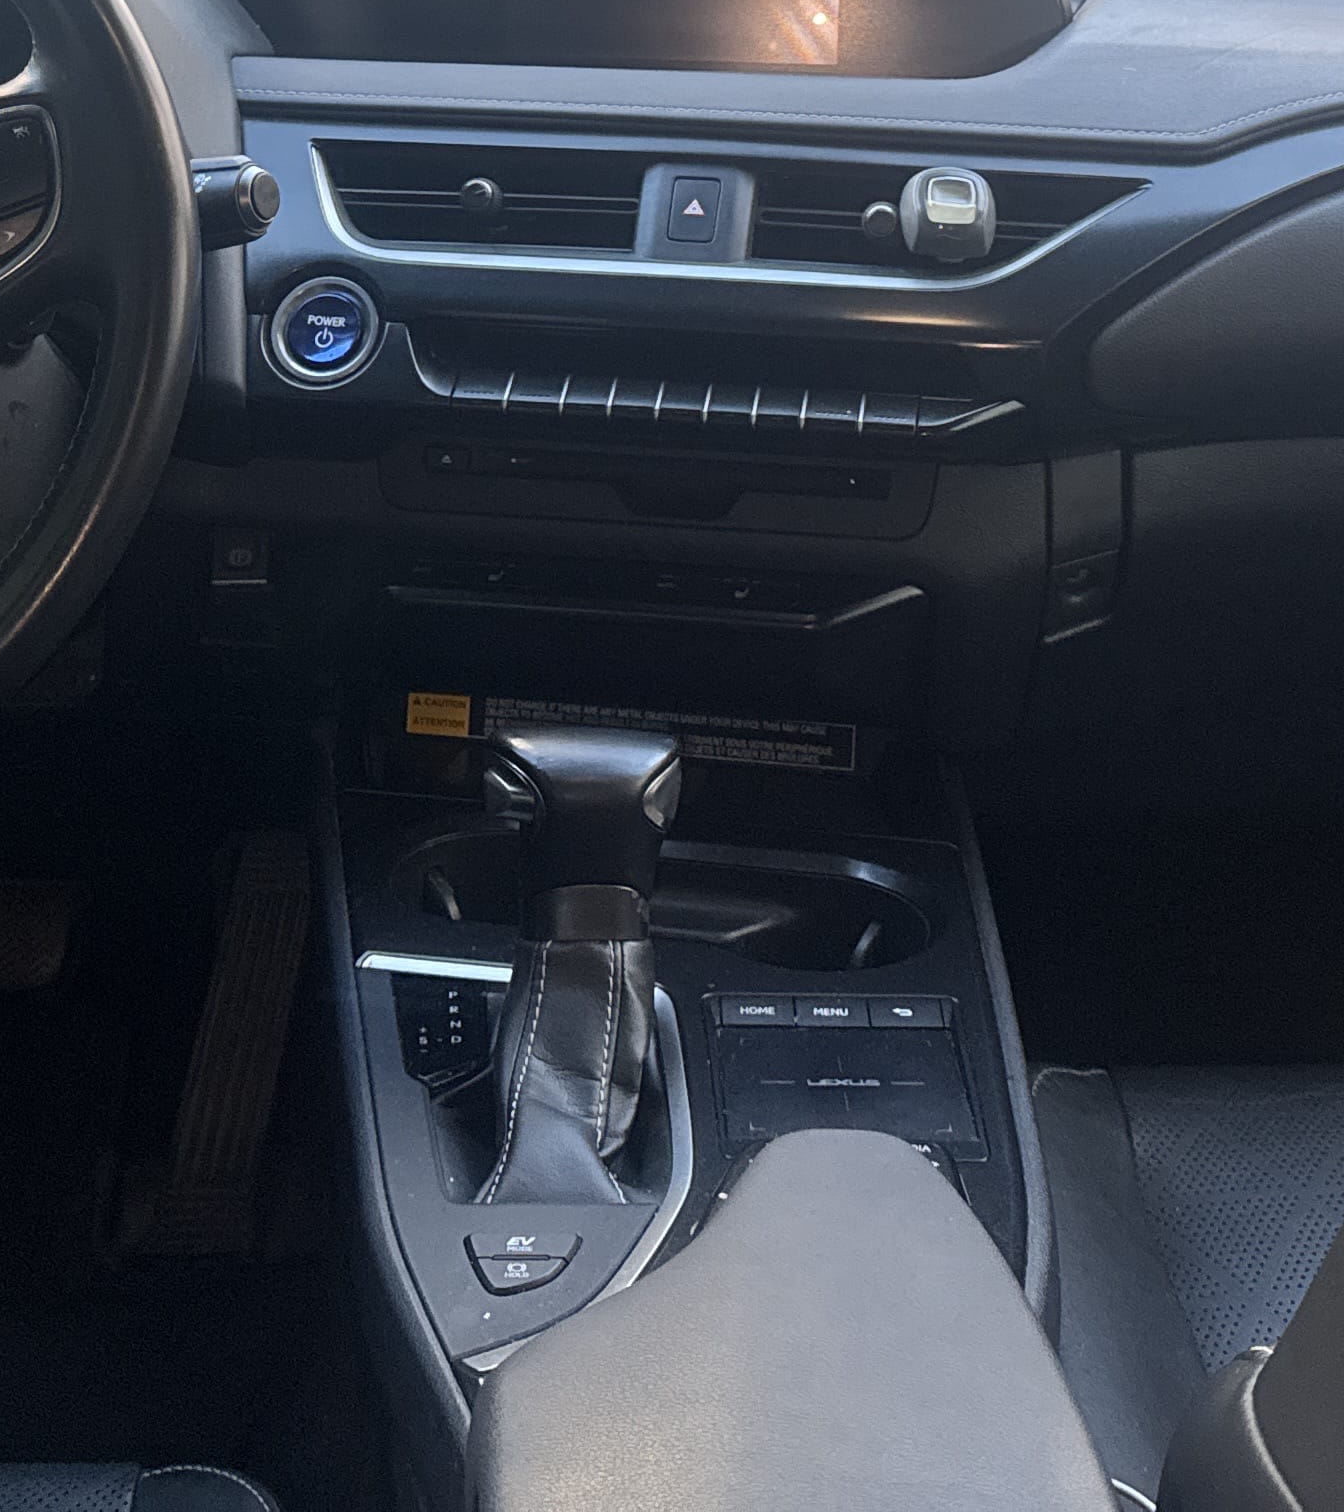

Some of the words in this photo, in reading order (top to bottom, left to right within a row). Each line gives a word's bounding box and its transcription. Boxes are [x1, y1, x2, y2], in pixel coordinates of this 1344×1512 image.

[306, 314, 346, 328] POWER
[424, 697, 466, 710] CAUTION
[412, 717, 466, 730] ATTENTION
[448, 991, 459, 1000] P
[449, 1005, 460, 1014] R
[739, 1005, 776, 1017] HOME
[813, 1006, 849, 1017] MENU
[450, 1019, 462, 1029] N
[450, 1034, 463, 1044] D
[806, 1078, 881, 1087] LEXUS
[506, 1236, 537, 1246] EV
[504, 1271, 530, 1279] HOLD
